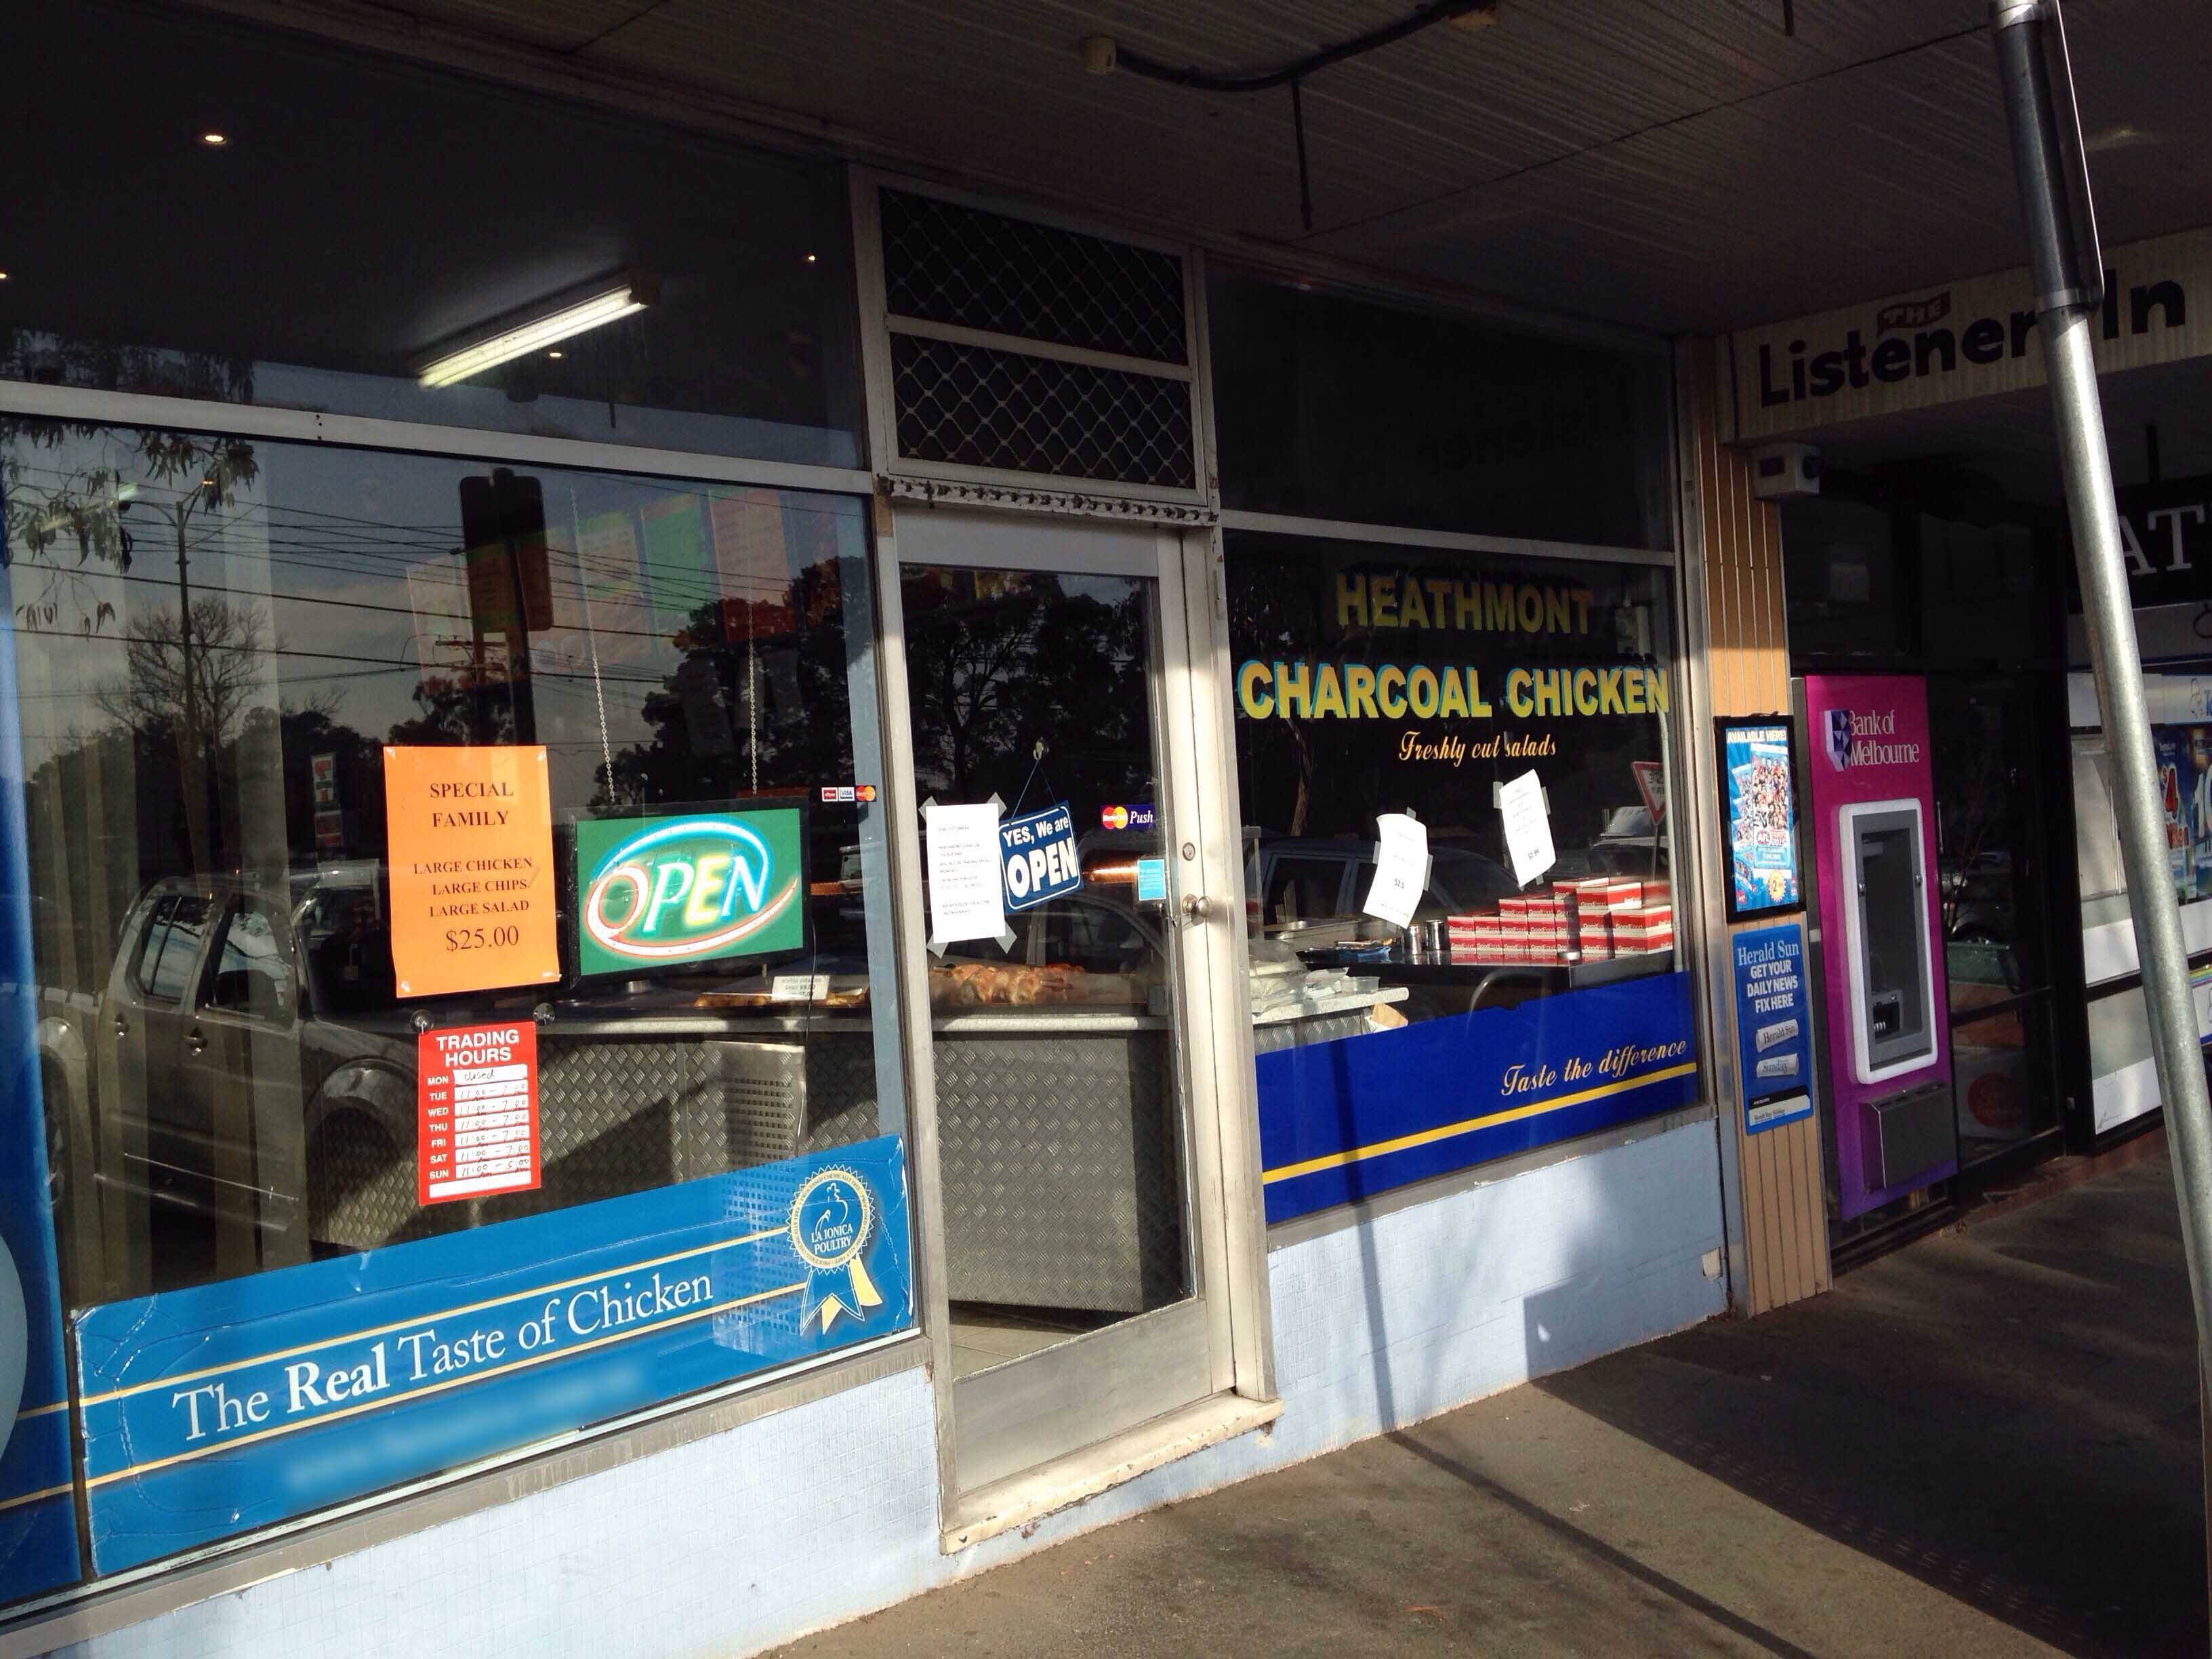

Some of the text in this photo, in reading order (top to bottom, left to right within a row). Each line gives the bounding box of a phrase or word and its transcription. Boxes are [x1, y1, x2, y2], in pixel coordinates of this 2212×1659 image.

[1881, 295, 1945, 329] THE
[1759, 310, 2039, 406] Listener
[1336, 573, 1593, 634] HEATHMONT
[1238, 659, 1670, 719] CHARCOAL CHICKEN
[1882, 710, 1895, 735] of
[1399, 731, 1556, 768] Freshly cut salads
[1849, 739, 1920, 766] Melbourne
[430, 781, 514, 798] SPECIAL
[433, 810, 508, 827] FAMILY
[1130, 810, 1153, 824] Push
[1002, 826, 1035, 848] YES,
[1036, 820, 1053, 838] We
[1054, 816, 1069, 832] are
[414, 857, 532, 874] LARGE CHICKEN
[1007, 837, 1078, 898] OPEN
[432, 882, 481, 895] LARGE
[585, 854, 767, 939] OPEN
[429, 899, 530, 918] LARGE SALAD
[446, 925, 519, 952] $25.00
[1738, 939, 1799, 966] Herald Sun
[1750, 959, 1793, 979] GET YOUR
[1746, 975, 1799, 998] DAILY NEWS
[1755, 993, 1795, 1013] FIX HERE
[436, 1029, 520, 1052] TRADING
[445, 1046, 512, 1067] HOURS
[464, 1069, 495, 1081] closed
[1501, 1040, 1687, 1096] Taste the difference
[427, 1075, 449, 1086] MON
[428, 1092, 447, 1101] TUE
[428, 1107, 449, 1117] WED
[428, 1122, 448, 1132] THU
[430, 1139, 447, 1148] FRI
[430, 1154, 448, 1164] SAT
[429, 1170, 449, 1179] SUN
[811, 1223, 853, 1243] LA IONICA
[814, 1235, 852, 1254] POULTRY
[172, 1272, 714, 1441] The Real Taste of Chicken
